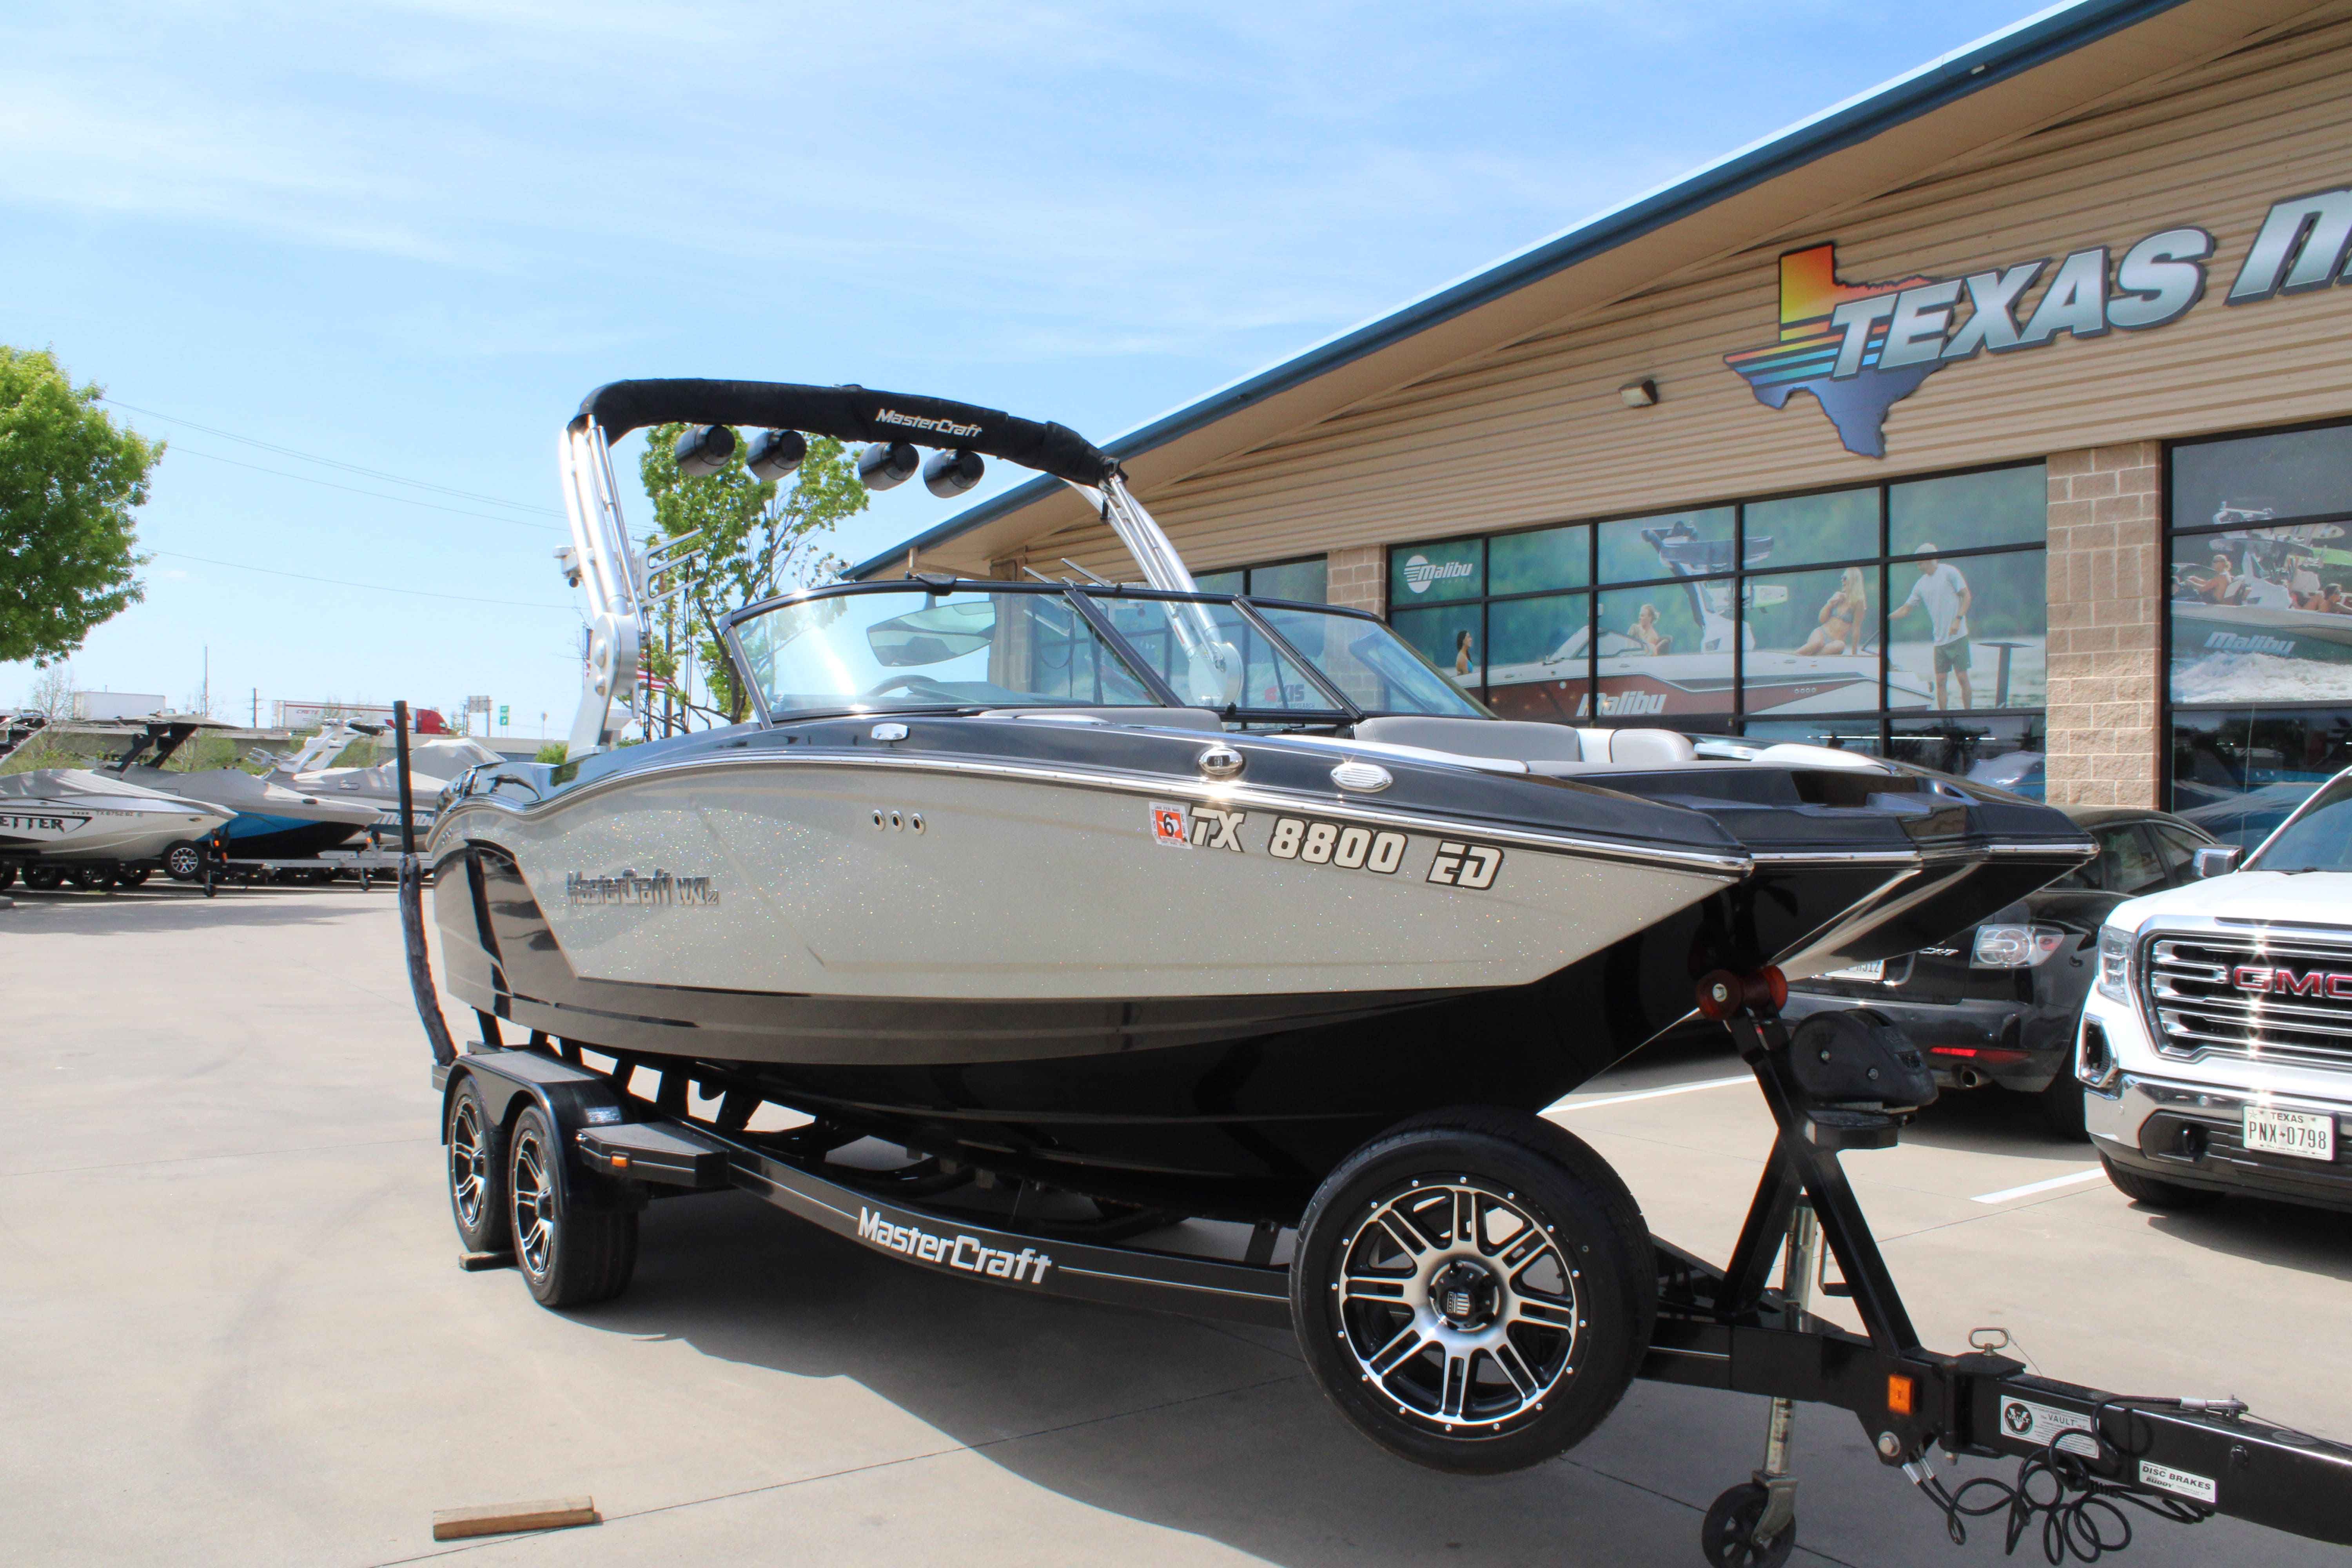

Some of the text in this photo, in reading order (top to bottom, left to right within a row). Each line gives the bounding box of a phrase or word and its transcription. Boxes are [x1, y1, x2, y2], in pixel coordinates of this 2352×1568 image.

[1830, 227, 2216, 381] TEXAS
[875, 408, 982, 437] MasterCraft
[1417, 562, 1473, 581] Malibu
[2204, 632, 2296, 655] Malibu
[1575, 691, 1667, 717] Malibu
[1163, 813, 1174, 836] 6
[1189, 806, 1504, 890] TX 8800 ED
[2234, 966, 2352, 1000] GMC
[2270, 1112, 2303, 1123] TEXAS
[858, 1207, 1052, 1283] MasterCraft
[2007, 1413, 2030, 1423] VAULT
[2048, 1414, 2075, 1426] VAULT
[2142, 1466, 2211, 1490] DISC BRAKES
[2146, 1477, 2172, 1488] BUDDY
